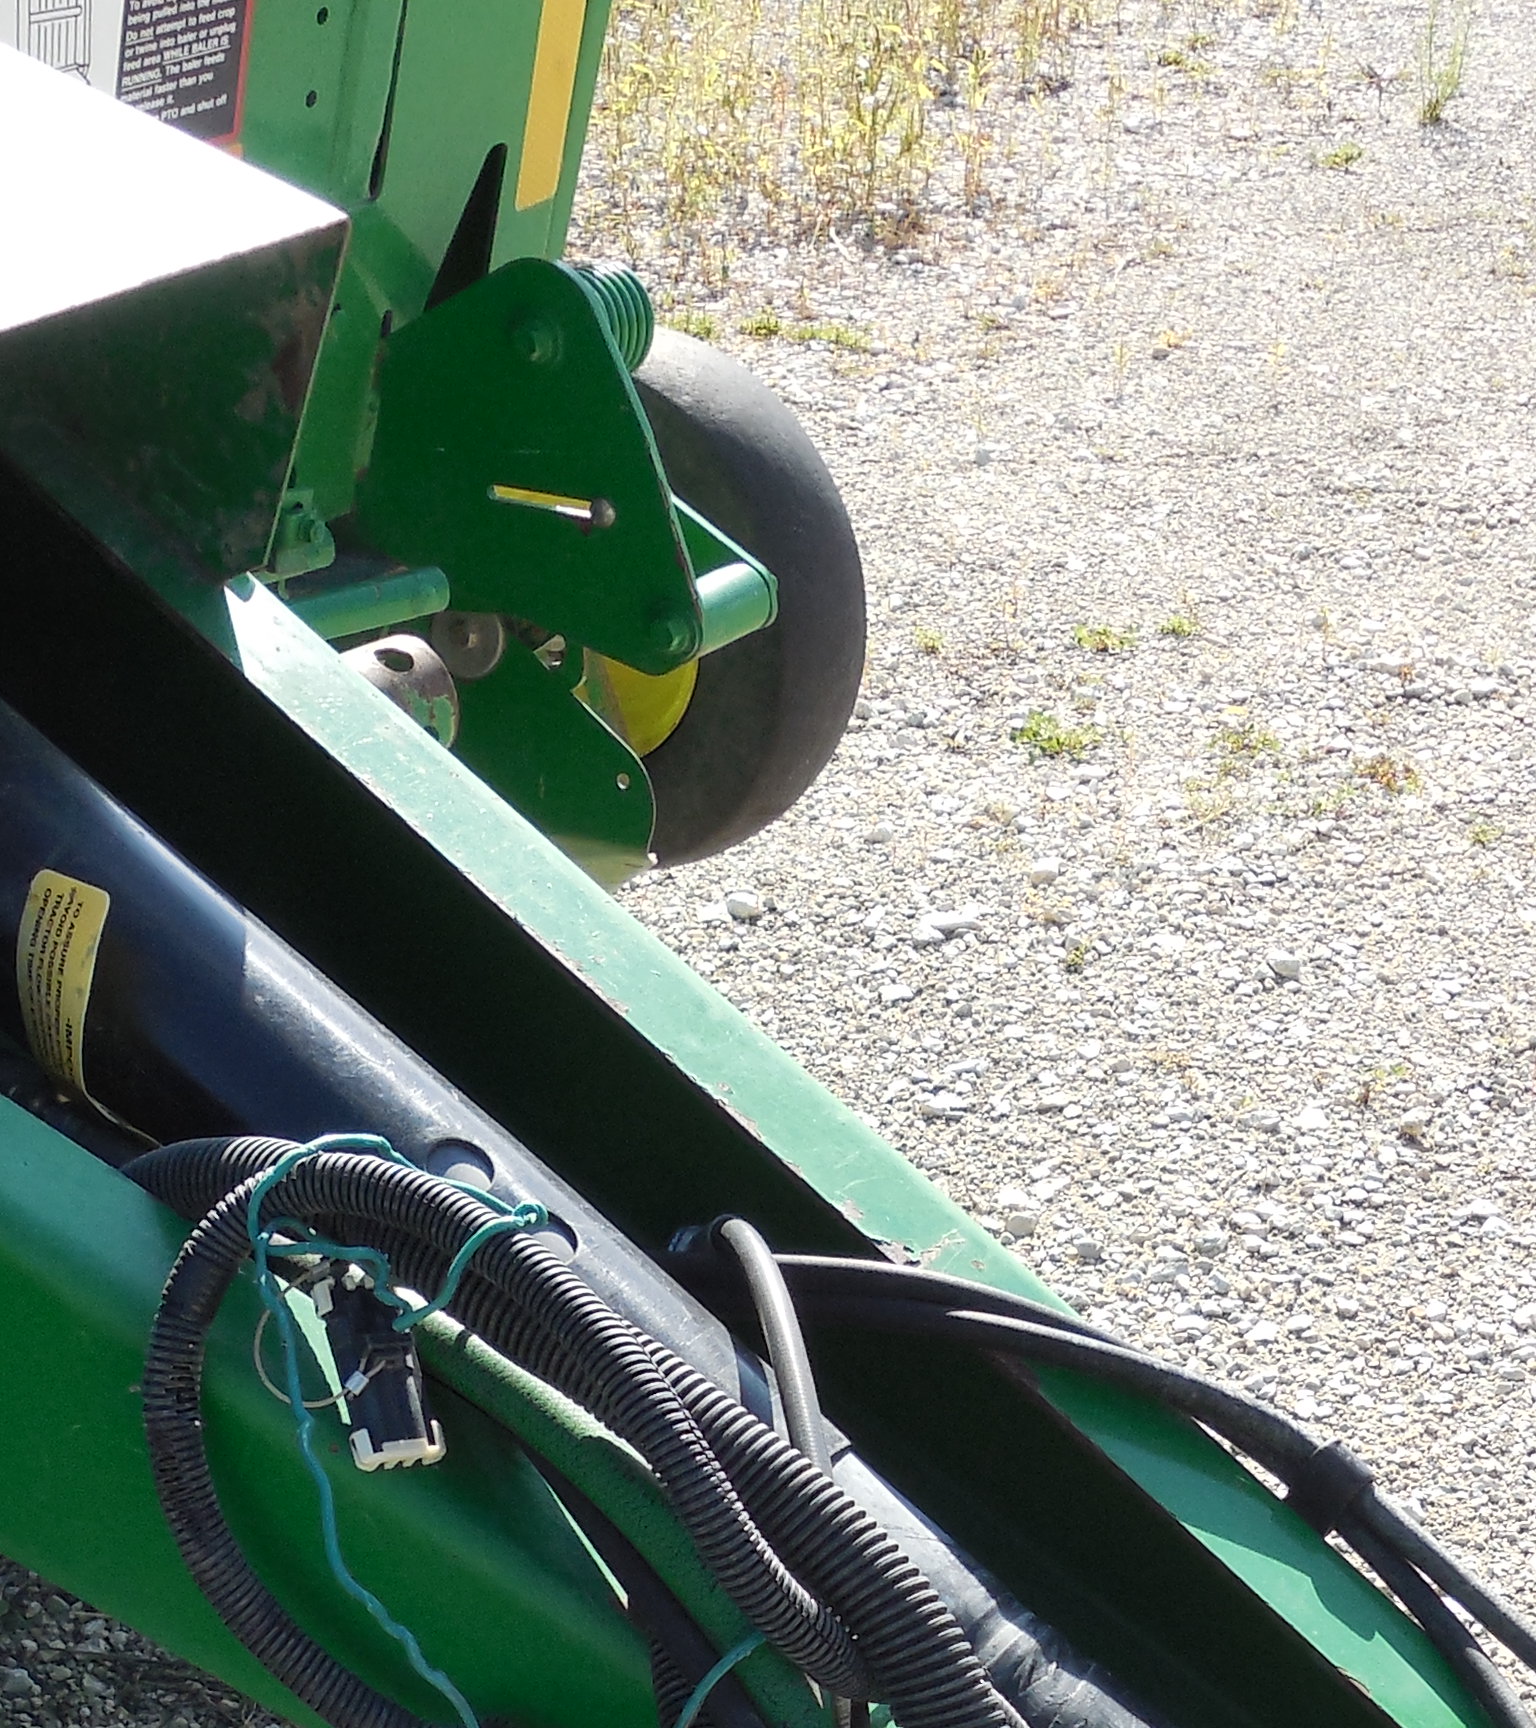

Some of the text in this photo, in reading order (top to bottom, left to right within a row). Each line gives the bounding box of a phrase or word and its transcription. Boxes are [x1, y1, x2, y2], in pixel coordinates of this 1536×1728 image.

[126, 8, 235, 41] Do not attempt to feed crop
[128, 12, 150, 25] being
[153, 6, 177, 21] pulled
[124, 36, 229, 71] feed area WHILE BALER IS
[125, 48, 133, 57] or
[178, 30, 197, 43] baler
[199, 29, 208, 38] or
[210, 23, 236, 36] unplug
[165, 64, 180, 76] The
[183, 58, 202, 72] baler
[205, 53, 225, 65] feeds
[155, 81, 177, 94] faster
[180, 76, 196, 88] than
[199, 71, 214, 85] you
[161, 108, 179, 120] PTO
[181, 104, 195, 115] and
[198, 100, 214, 111] shut
[216, 94, 228, 106] off
[30, 887, 52, 947] OPENING
[40, 893, 64, 954] TRACTOR
[73, 901, 84, 919] TO
[58, 921, 76, 976] ASSURE
